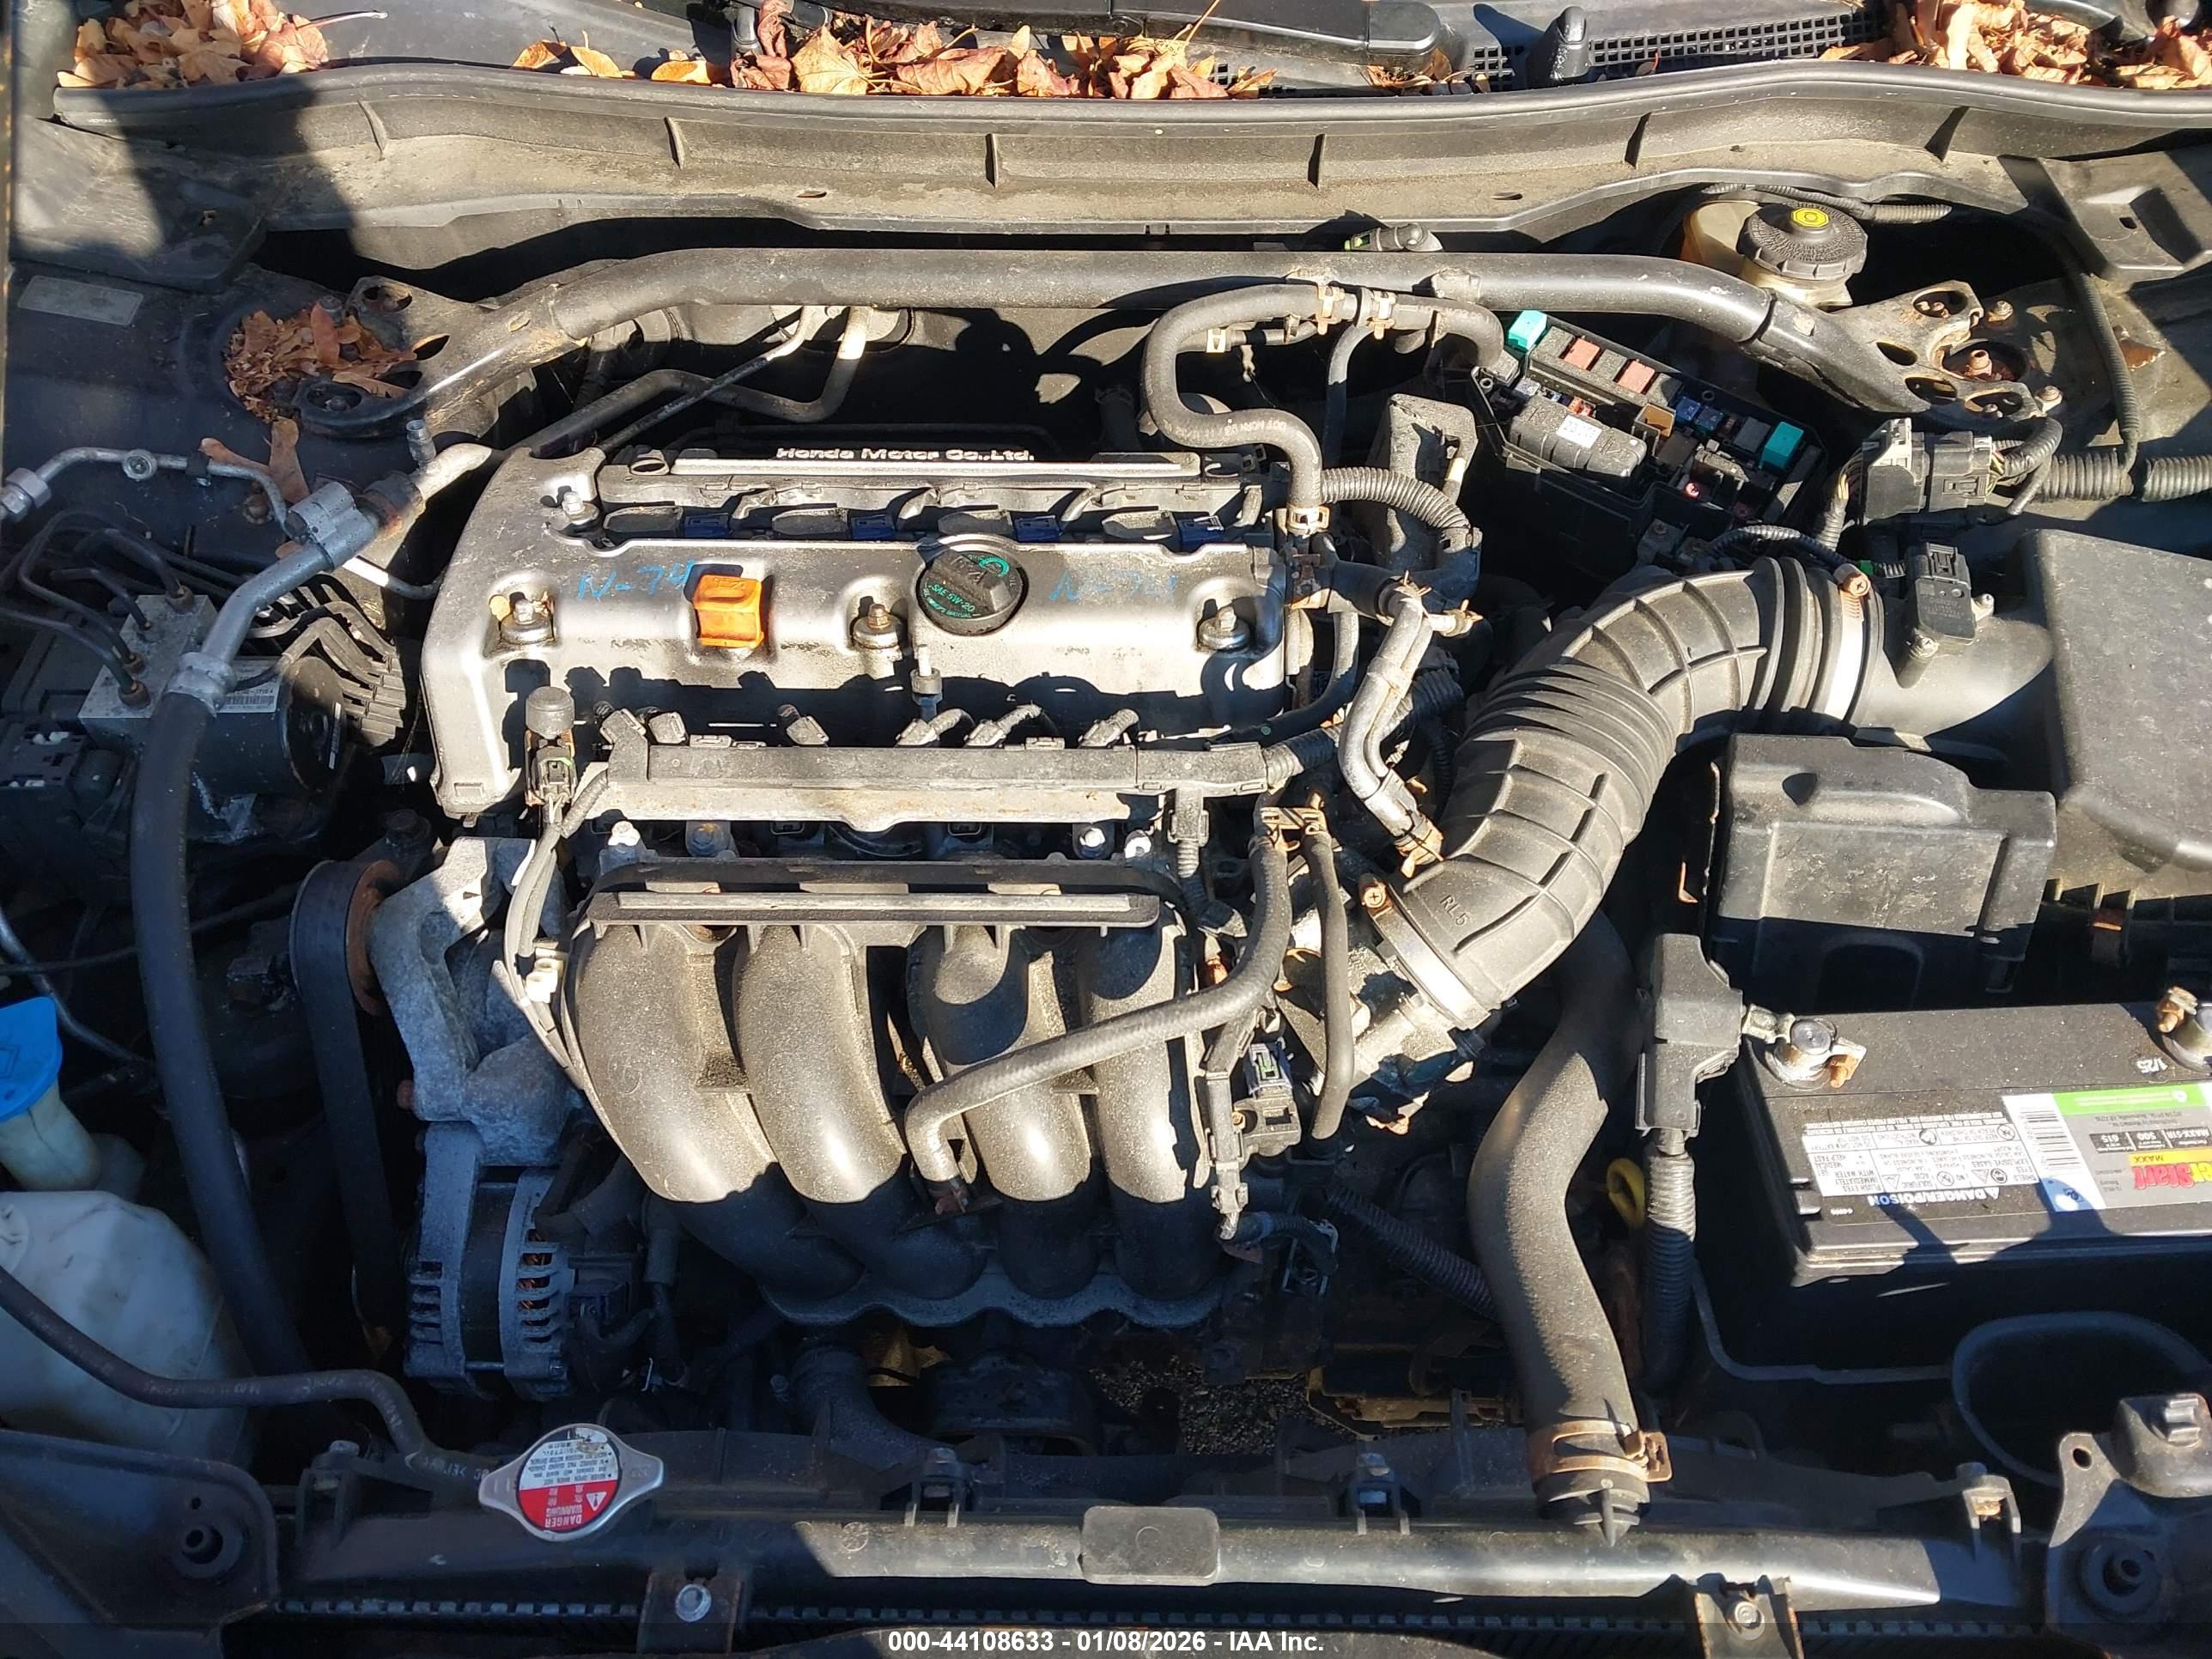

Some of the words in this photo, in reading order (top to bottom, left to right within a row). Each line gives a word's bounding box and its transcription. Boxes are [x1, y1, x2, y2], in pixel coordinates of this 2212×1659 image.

[776, 447, 855, 460] Honda
[861, 447, 939, 460] Motor
[932, 584, 947, 596] SAE
[1439, 894, 1470, 926] RL5
[2136, 1057, 2167, 1073] 1/25
[2100, 1134, 2119, 1143] 615
[2136, 1132, 2157, 1140] 500
[2134, 1155, 2164, 1164] MAXX
[1867, 1188, 1986, 1206] DANGER/POISON
[544, 1514, 582, 1528] DANGER
